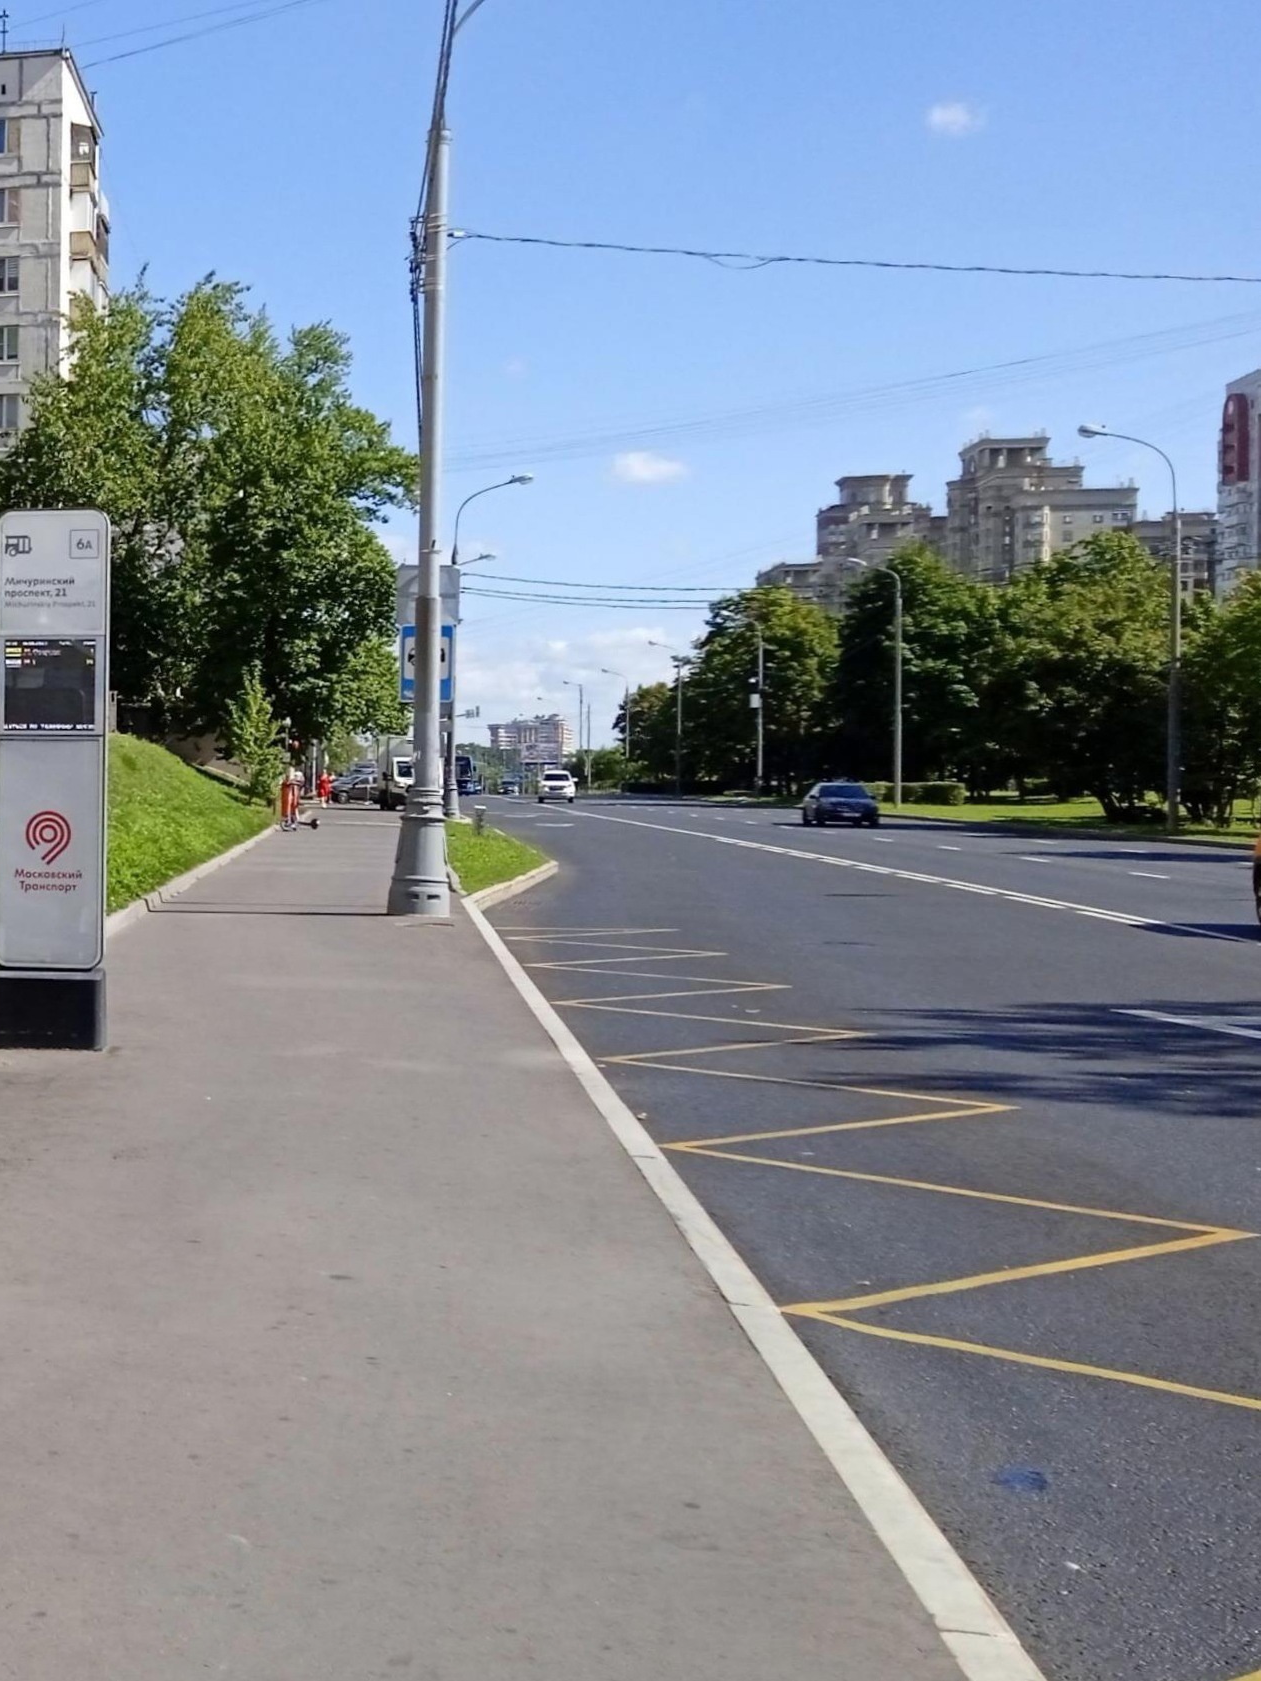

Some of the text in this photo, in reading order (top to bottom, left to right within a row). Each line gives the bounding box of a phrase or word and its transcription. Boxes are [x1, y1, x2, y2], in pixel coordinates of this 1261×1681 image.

[4, 577, 75, 587] Мичуринский
[55, 588, 67, 597] 21
[14, 868, 83, 879] Московский
[19, 880, 77, 893] Транспорт
